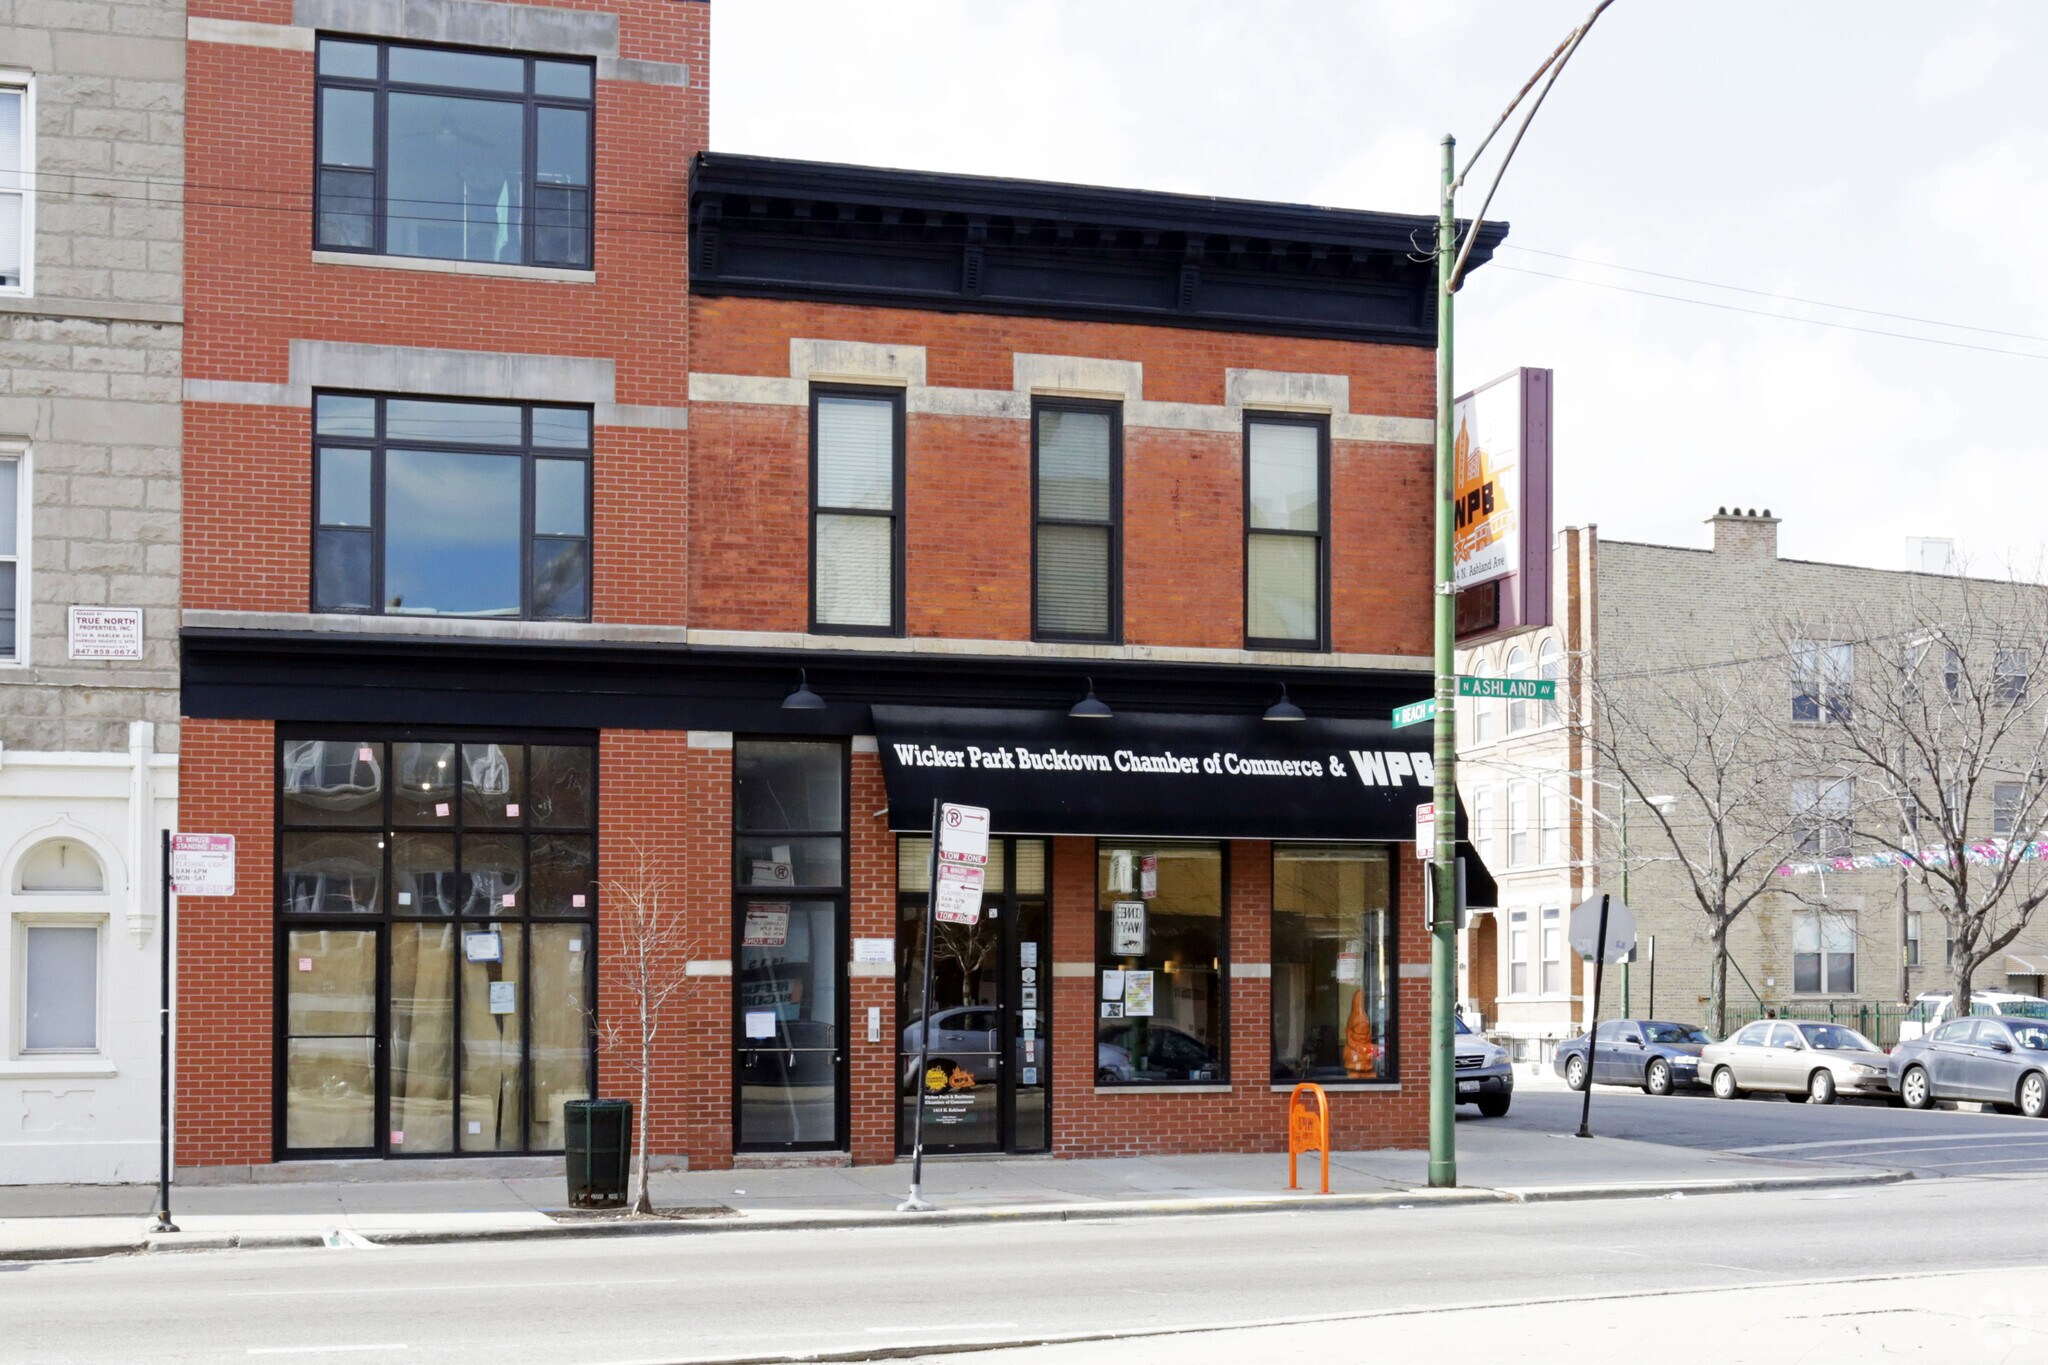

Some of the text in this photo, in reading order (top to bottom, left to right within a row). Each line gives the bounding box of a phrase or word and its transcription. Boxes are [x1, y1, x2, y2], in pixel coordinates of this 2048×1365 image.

[1469, 559, 1492, 576] Ashland
[1493, 556, 1504, 568] Ave
[1464, 680, 1550, 696] N ASHLAND AV
[1402, 704, 1425, 723] BEACH
[893, 744, 1434, 787] Wicker Park Bucktown Chamber of Commerce & WPB
[944, 851, 983, 863] TOW ZONE
[956, 914, 974, 922] ZONE
